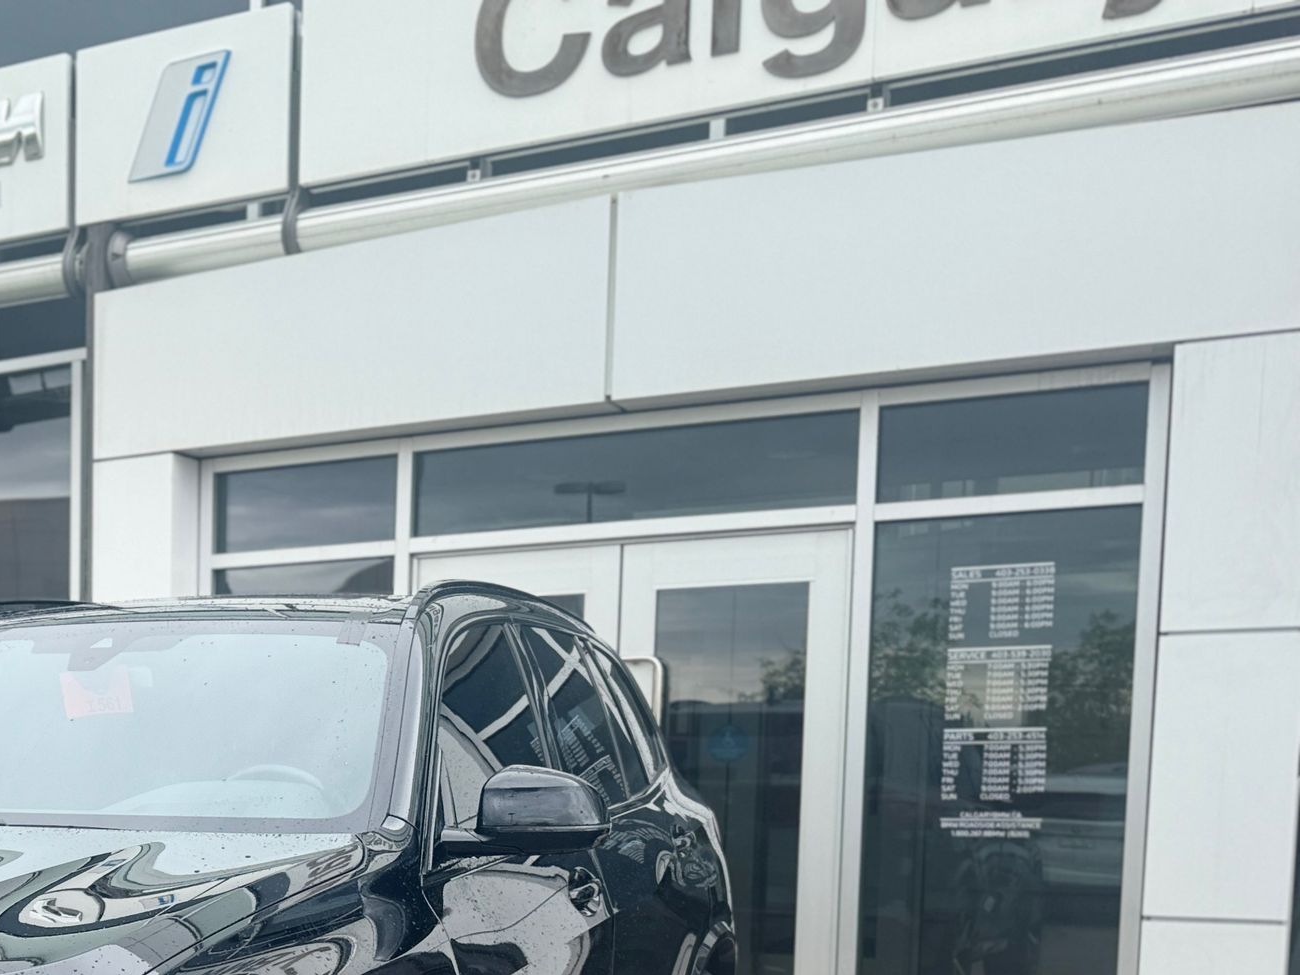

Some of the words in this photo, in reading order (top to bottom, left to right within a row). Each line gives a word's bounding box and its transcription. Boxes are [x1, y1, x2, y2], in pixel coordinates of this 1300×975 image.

[951, 570, 982, 579] SALES
[988, 630, 1019, 639] CLOSED
[948, 651, 985, 660] SERVICE
[983, 712, 1014, 720] CLOSED
[944, 732, 974, 741] PARTS
[979, 792, 1010, 801] CLOSED
